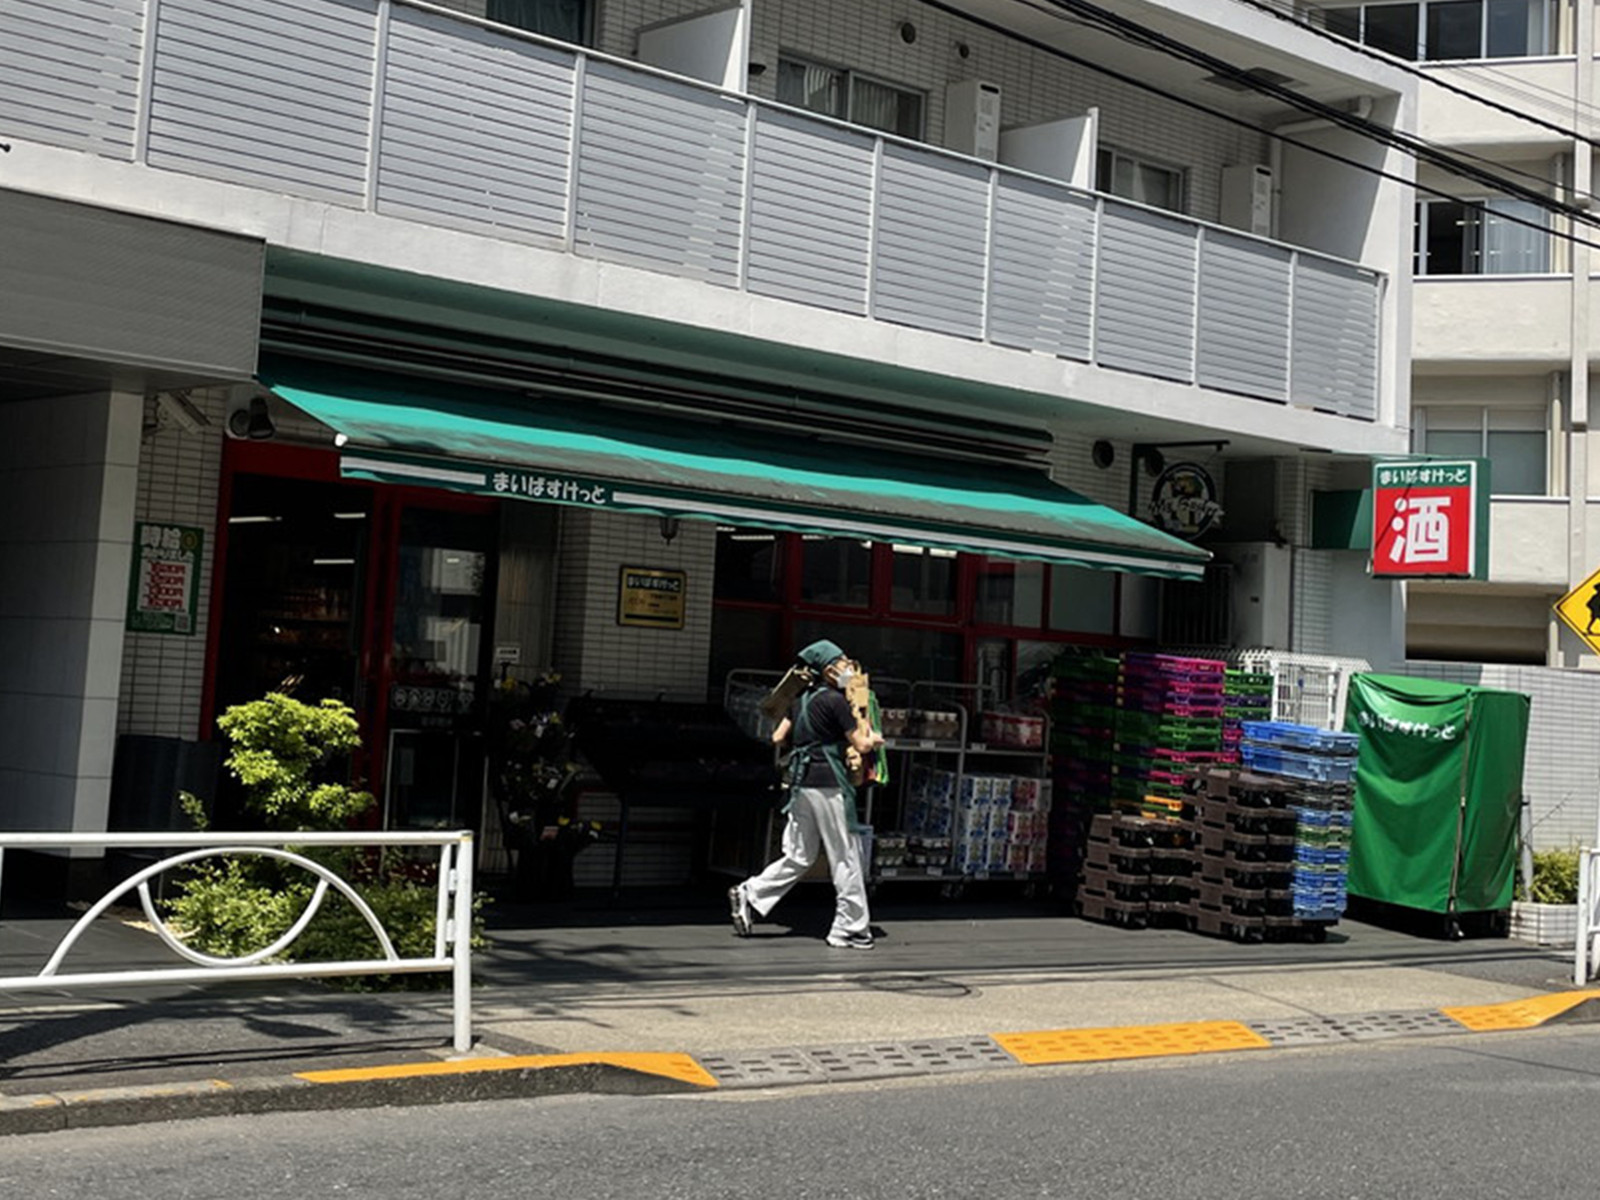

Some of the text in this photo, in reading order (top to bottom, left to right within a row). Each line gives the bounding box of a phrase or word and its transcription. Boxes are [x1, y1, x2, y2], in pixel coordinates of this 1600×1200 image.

[493, 472, 606, 504] まいばすけっと
[1380, 468, 1467, 485] まいばすけっと
[1389, 496, 1451, 563] 酒
[1359, 710, 1456, 740] まいばすけっと
